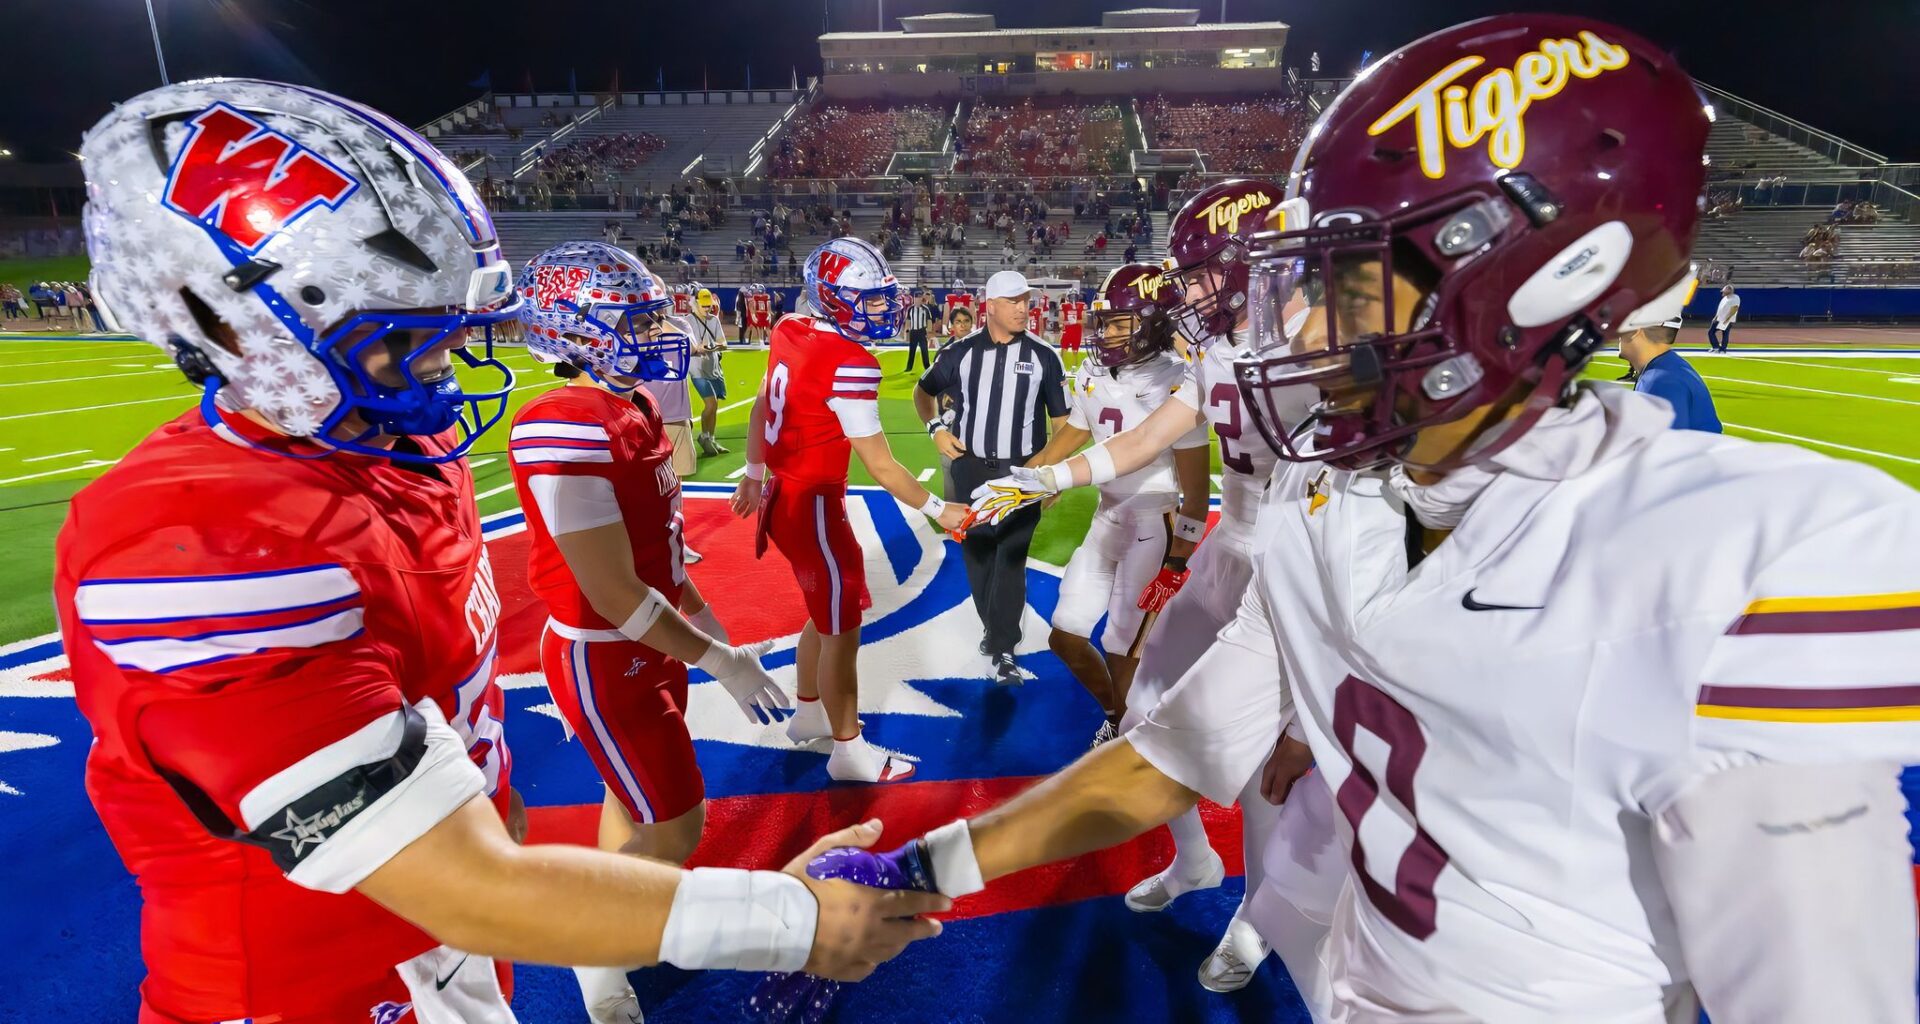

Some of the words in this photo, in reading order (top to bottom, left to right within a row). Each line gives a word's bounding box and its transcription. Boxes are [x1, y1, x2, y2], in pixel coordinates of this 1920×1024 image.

[1367, 30, 1631, 180] Tigers
[161, 101, 360, 256] W
[1195, 190, 1271, 234] Tigers
[535, 264, 593, 313] W
[817, 250, 855, 285] W
[1127, 272, 1172, 301] Tige
[764, 361, 789, 446] 9
[1210, 382, 1255, 475] 2
[1333, 673, 1449, 942] 0
